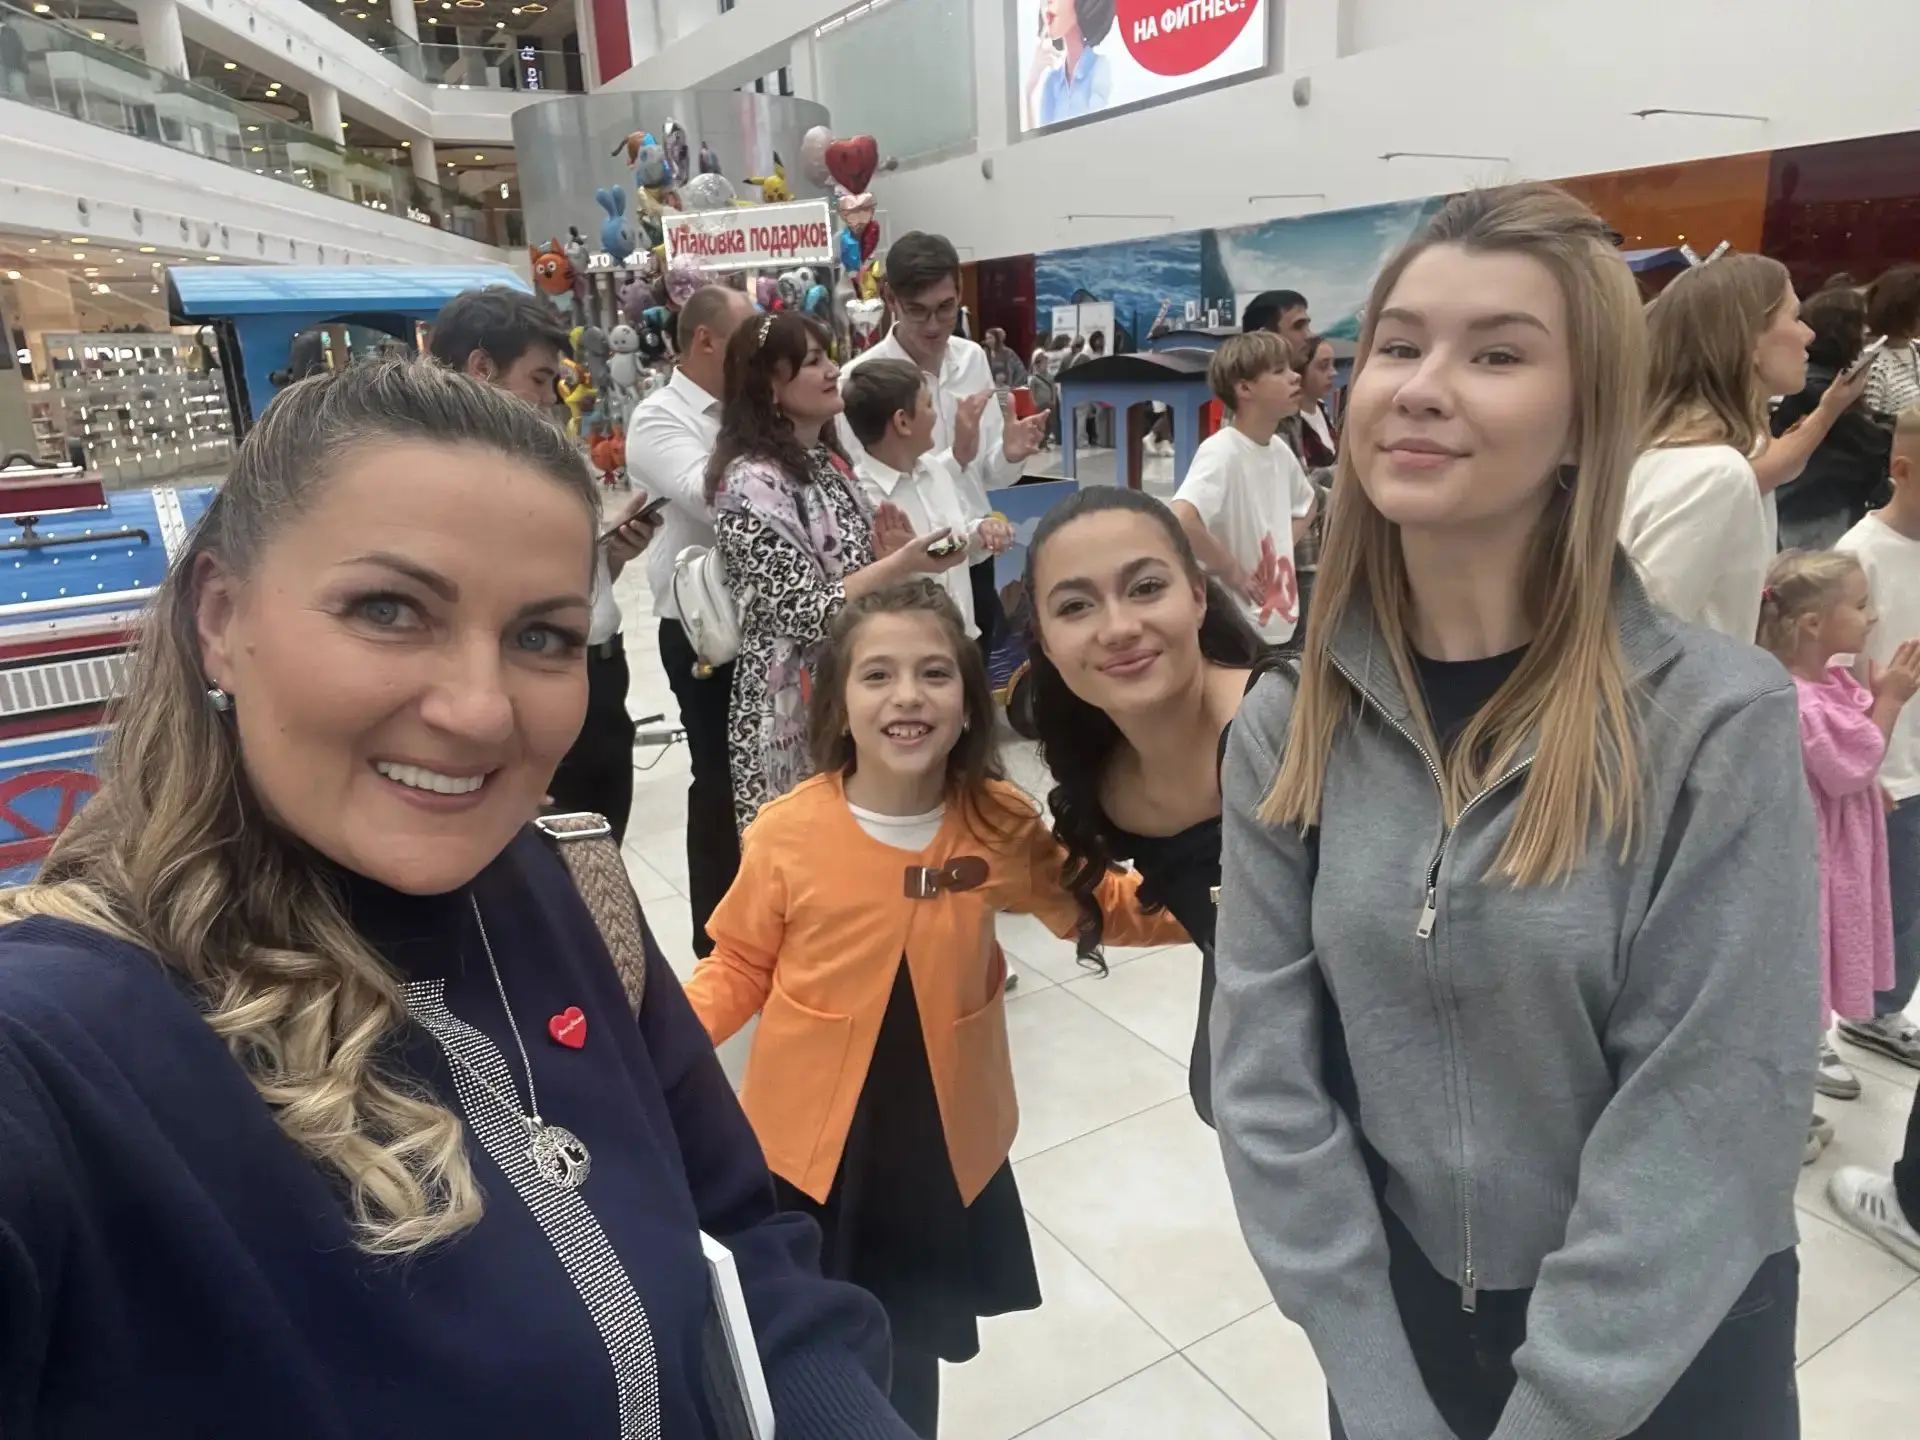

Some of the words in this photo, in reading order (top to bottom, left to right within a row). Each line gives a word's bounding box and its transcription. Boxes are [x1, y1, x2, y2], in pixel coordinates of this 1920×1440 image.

[1133, 15, 1158, 44] НА
[668, 228, 746, 258] Упаковка
[749, 222, 829, 257] подарков
